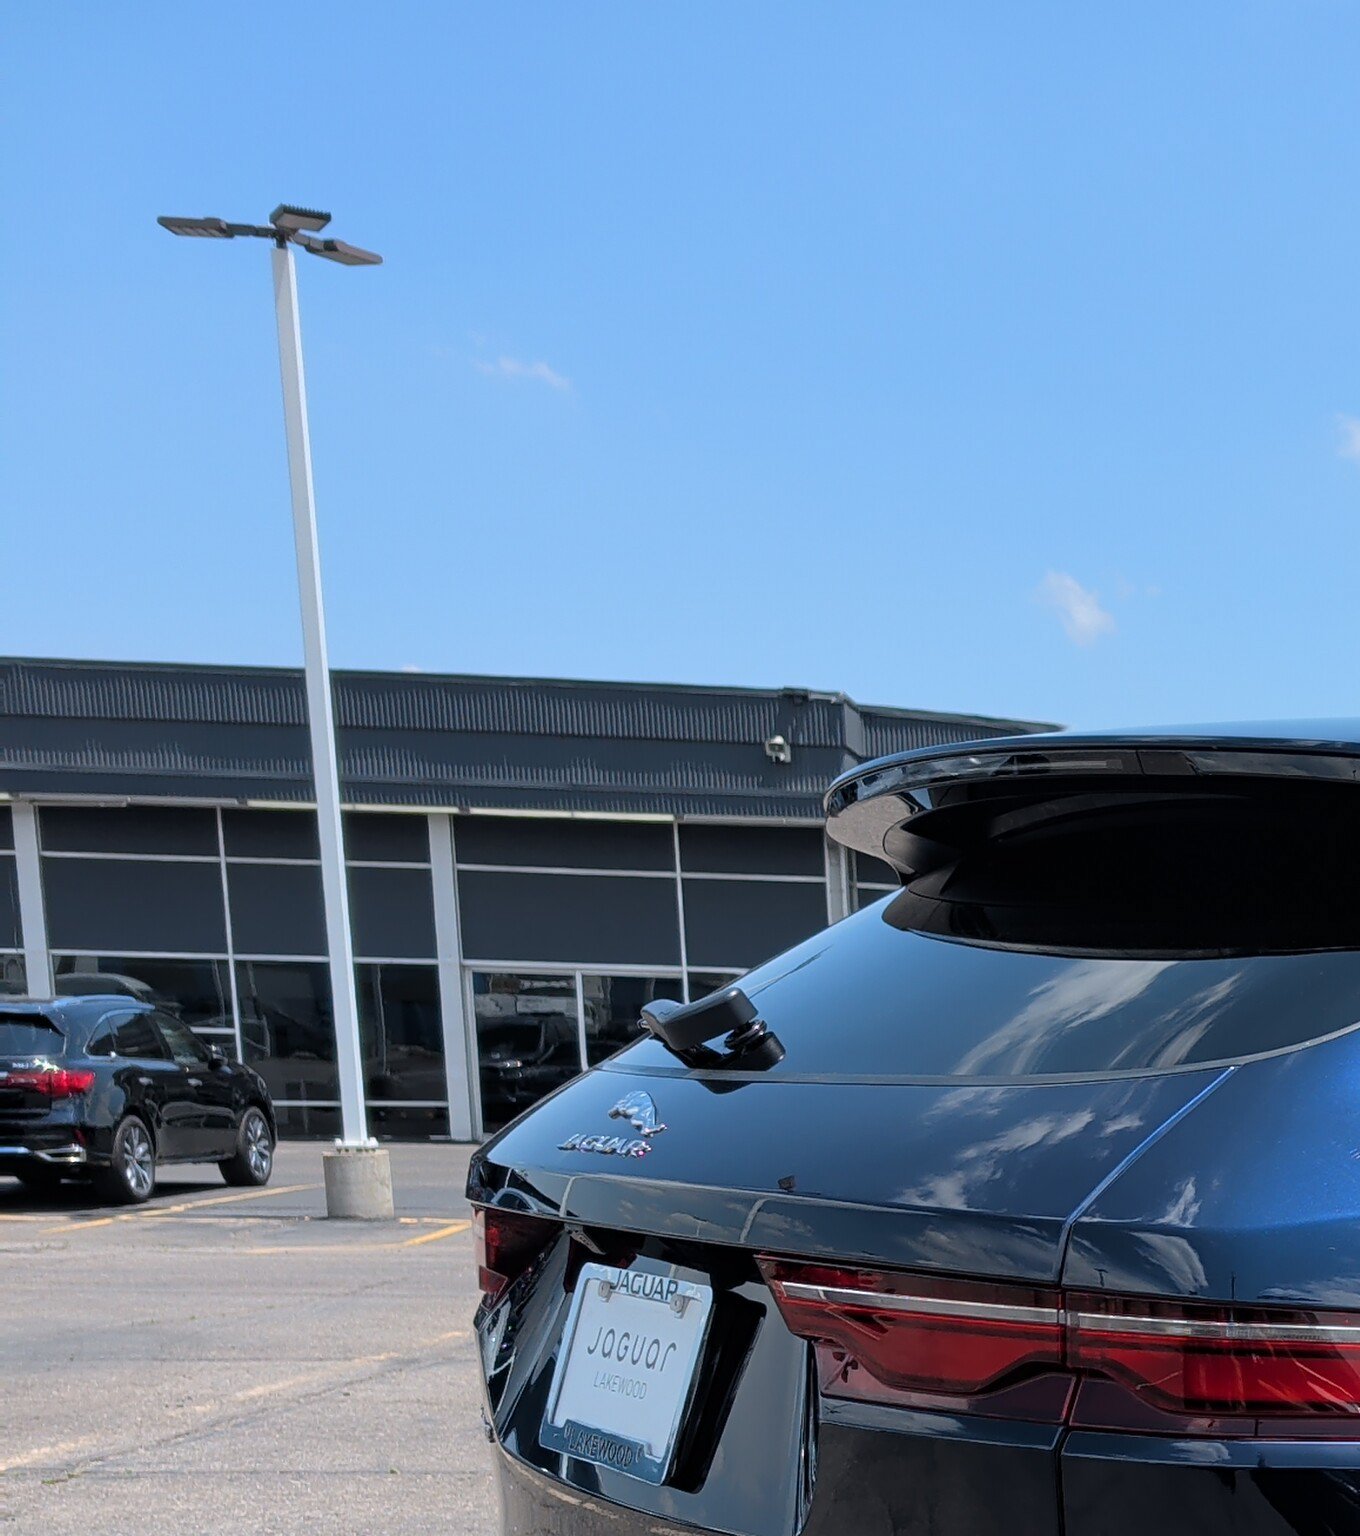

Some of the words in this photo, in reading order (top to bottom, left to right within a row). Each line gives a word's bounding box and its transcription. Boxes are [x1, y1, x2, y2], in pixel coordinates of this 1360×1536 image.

[611, 1270, 679, 1300] JAGUAR
[593, 1371, 648, 1400] LAKEWOOD
[568, 1430, 634, 1468] LAKEWOOD
